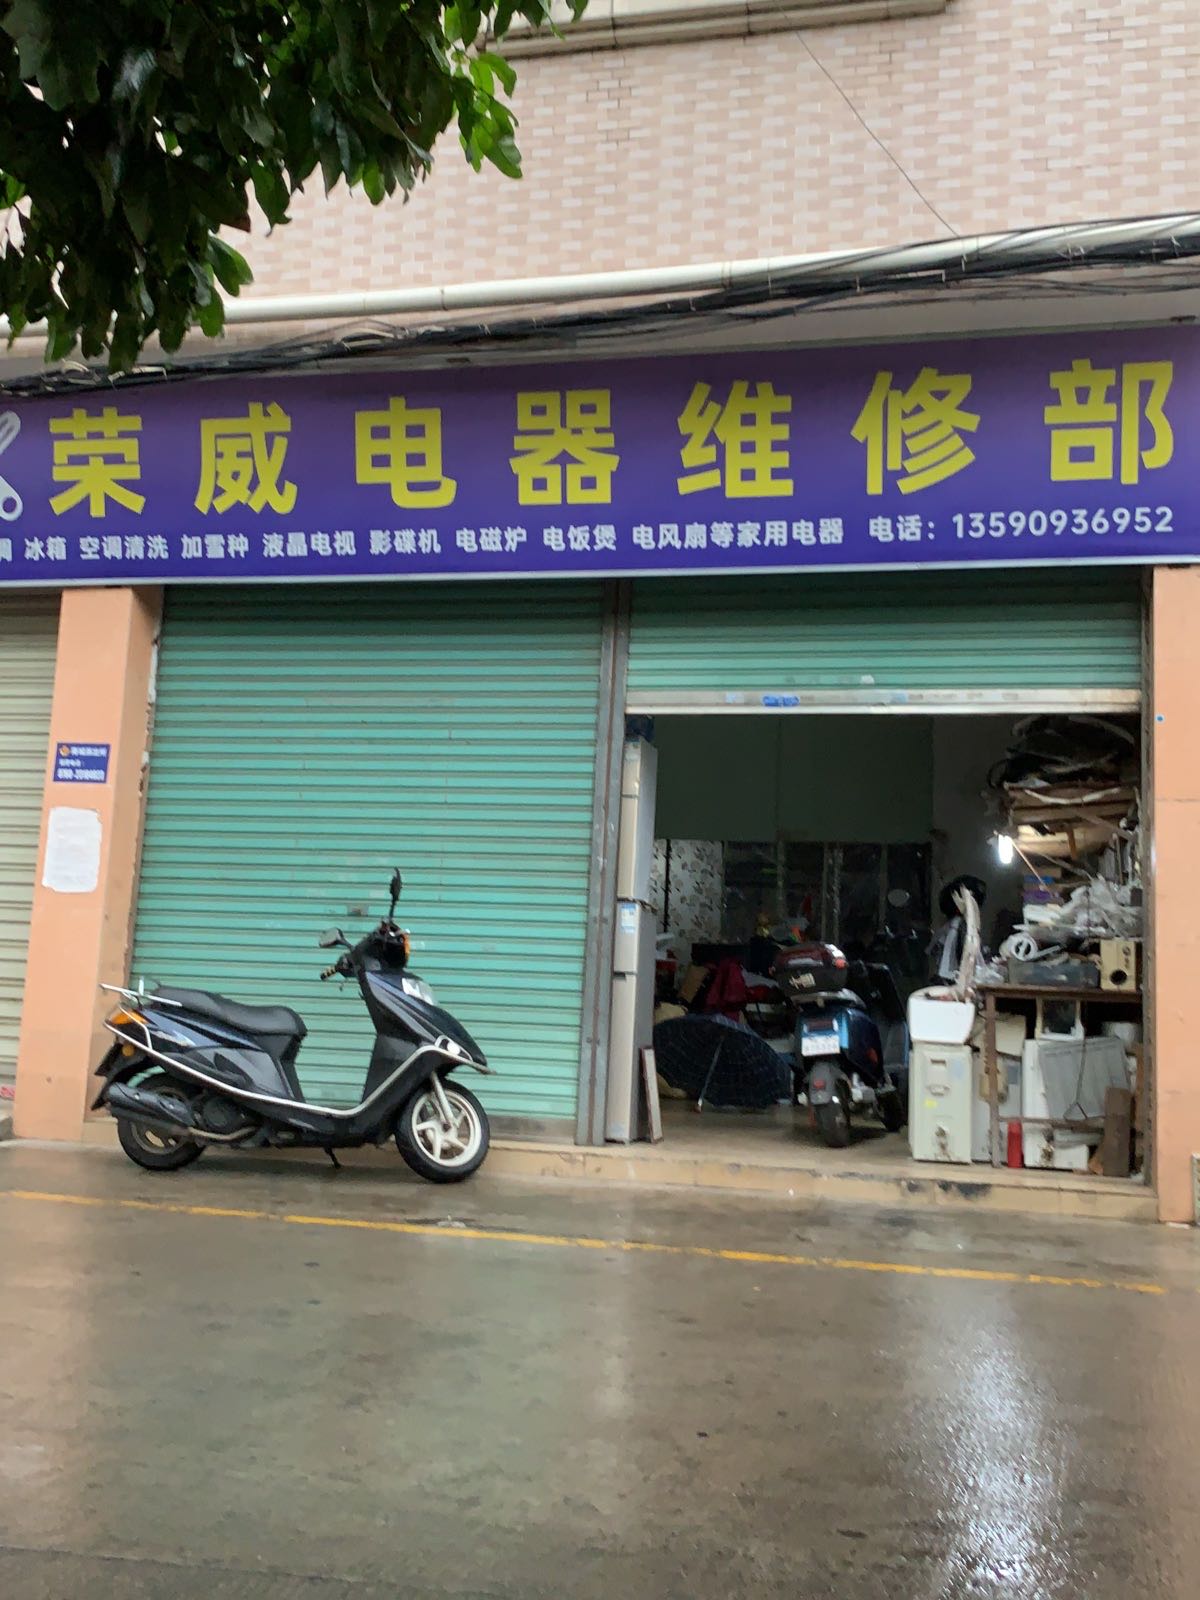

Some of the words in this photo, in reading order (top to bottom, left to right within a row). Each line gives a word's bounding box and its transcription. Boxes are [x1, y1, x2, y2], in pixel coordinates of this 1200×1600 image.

[49, 359, 1172, 516] 荣威电器维修部
[24, 536, 67, 561] 冰箱
[79, 534, 169, 560] 空调清洗
[262, 530, 356, 558] 液晶电视
[369, 528, 442, 555] 影碟机
[455, 526, 527, 553] 电磁炉
[543, 524, 617, 551] 电饭煲
[632, 518, 844, 550] 电风扇等家用电器
[952, 506, 1173, 539] 13590936952
